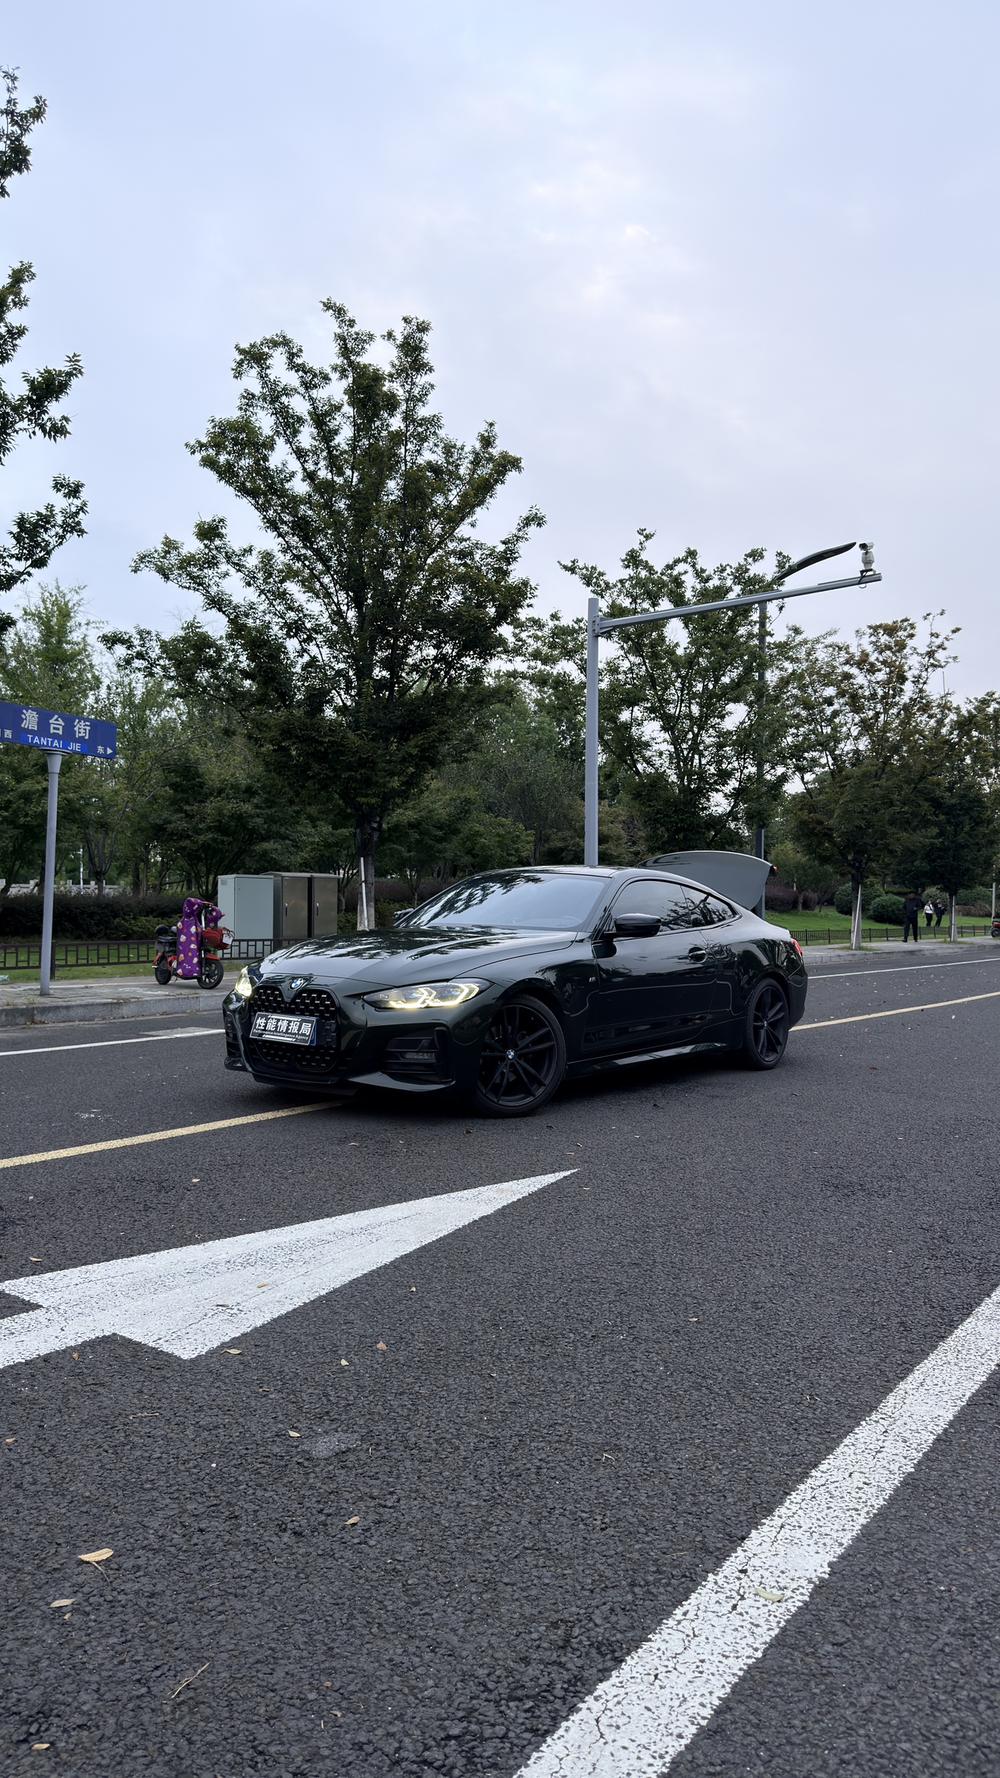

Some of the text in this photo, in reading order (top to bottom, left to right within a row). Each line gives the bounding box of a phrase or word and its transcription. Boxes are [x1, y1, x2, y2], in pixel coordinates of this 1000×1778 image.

[21, 709, 91, 739] 澹台街
[4, 729, 12, 739] 西
[27, 734, 82, 752] TANTAI JIE
[97, 746, 104, 754] 东
[256, 1017, 312, 1035] 性能情报局
